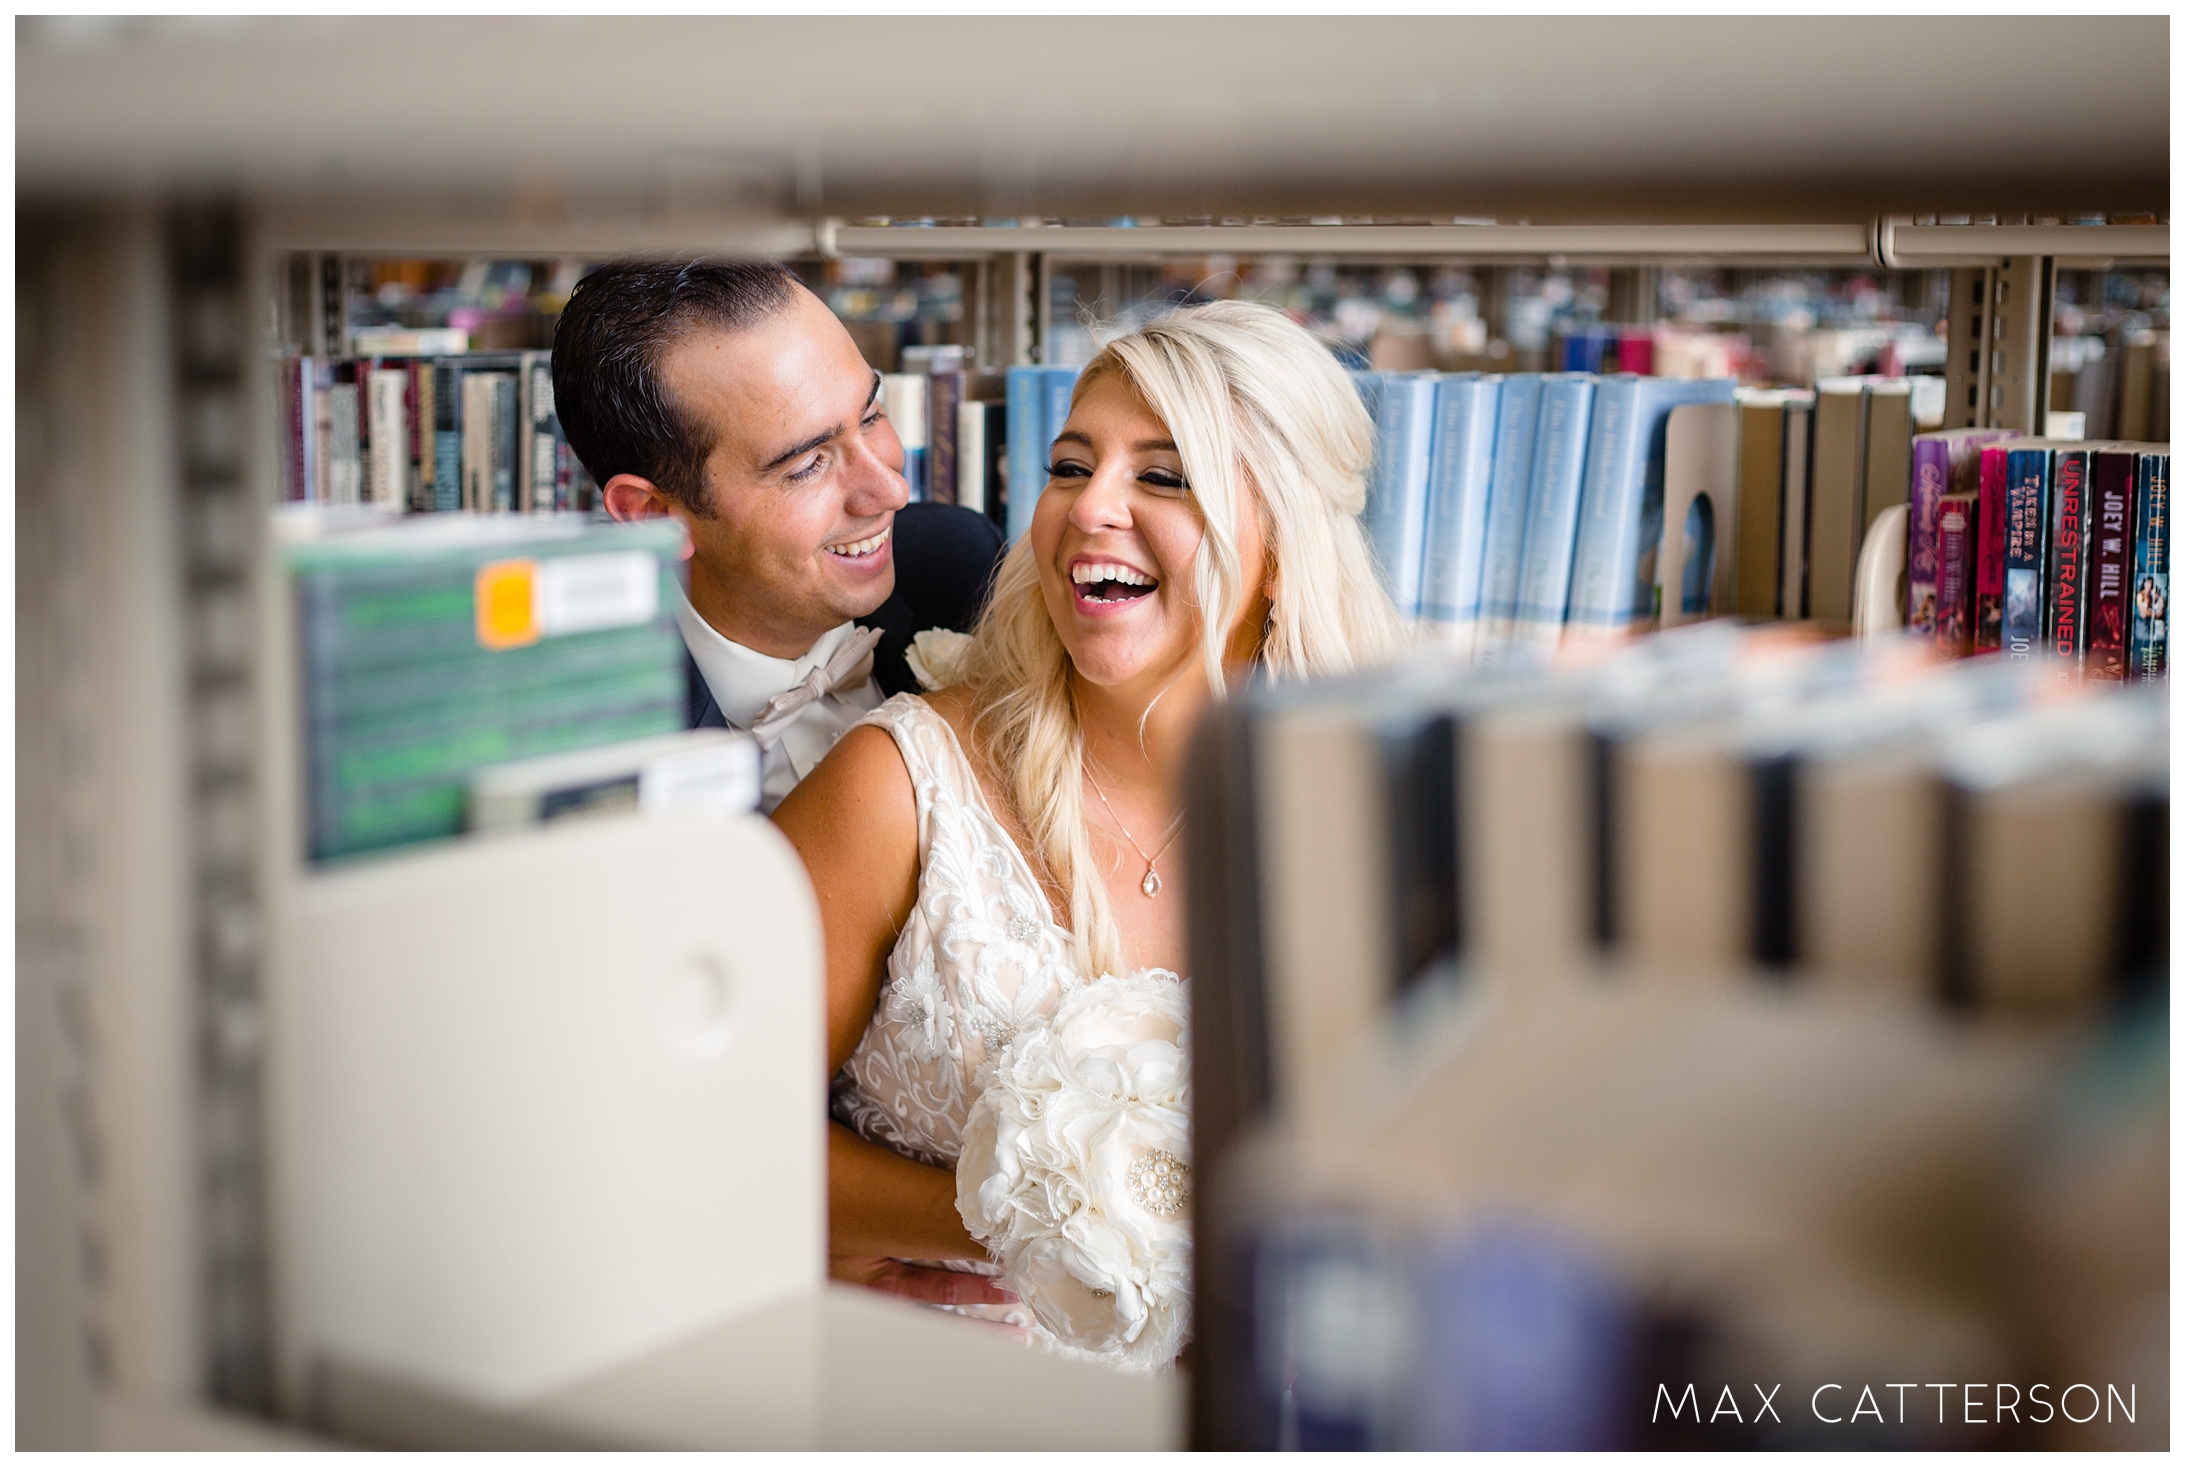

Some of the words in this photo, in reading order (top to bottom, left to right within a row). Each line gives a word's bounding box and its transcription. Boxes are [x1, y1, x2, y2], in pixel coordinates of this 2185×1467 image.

[2151, 475, 2167, 509] JOEY
[2009, 485, 2026, 559] VAMPIRE
[2102, 490, 2124, 533] JOEY
[2149, 515, 2165, 532] W.
[2056, 459, 2080, 658] UNRESTRAINED
[2101, 537, 2121, 557] W.
[2147, 537, 2164, 567] HILL
[2100, 563, 2121, 600] HILL
[2010, 634, 2031, 669] JOEY
